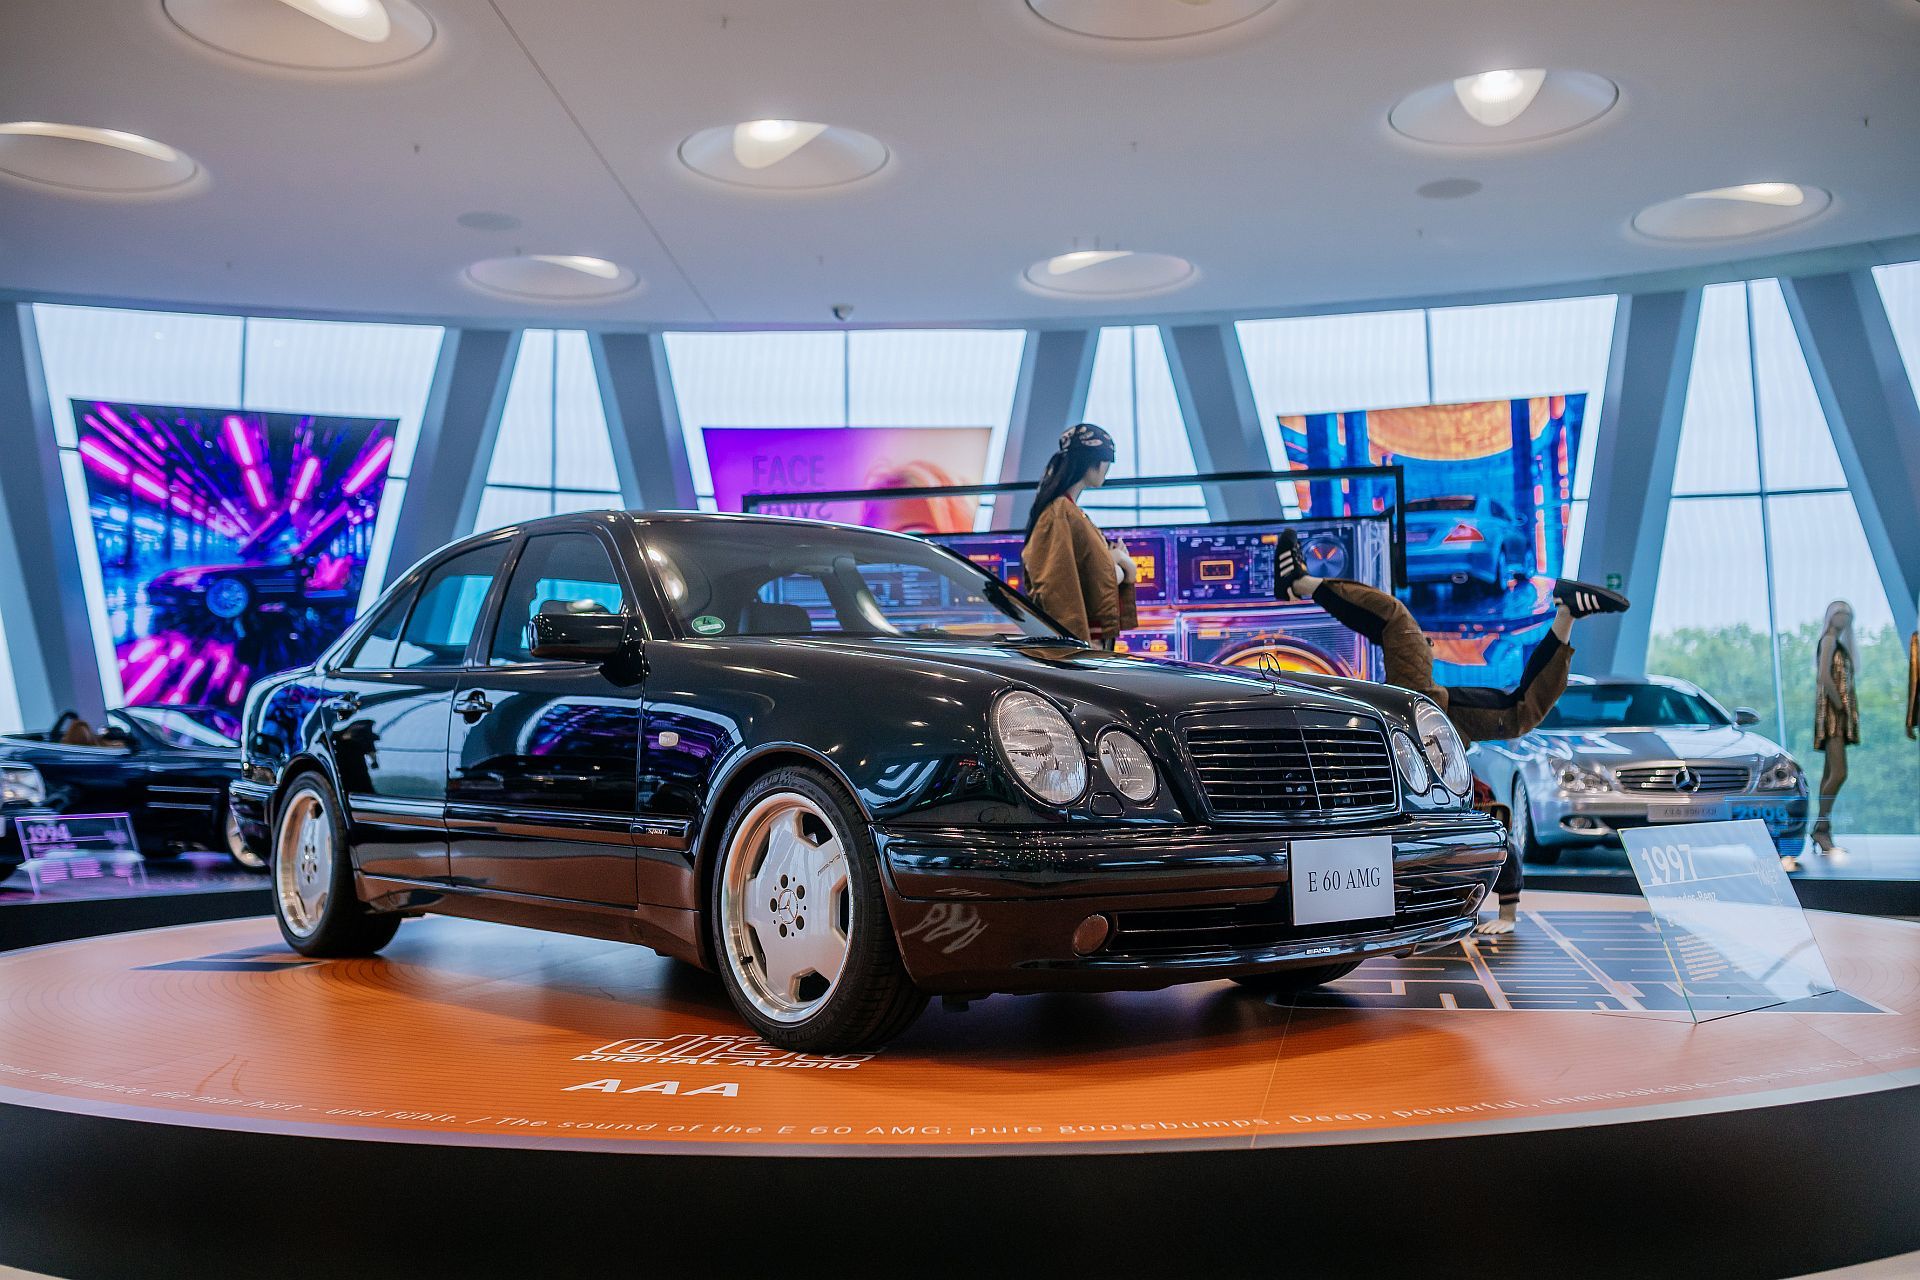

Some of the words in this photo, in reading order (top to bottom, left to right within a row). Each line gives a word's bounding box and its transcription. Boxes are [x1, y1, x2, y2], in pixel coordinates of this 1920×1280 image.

[752, 455, 824, 488] FACE
[1641, 844, 1699, 885] 1997
[1308, 871, 1318, 893] E
[1322, 870, 1341, 891] 60
[1345, 867, 1381, 890] AMG
[571, 1055, 719, 1065] DIGITAL
[728, 1060, 861, 1070] AUDIO
[561, 1078, 740, 1097] AAA
[243, 1100, 303, 1111] hört
[325, 1107, 384, 1117] und
[384, 1110, 456, 1123] fühlt.
[496, 1117, 548, 1127] The
[557, 1121, 657, 1132] sound
[667, 1124, 703, 1133] of
[711, 1125, 762, 1134] the
[777, 1125, 797, 1135] E
[810, 1126, 853, 1135] 60
[866, 1126, 952, 1135] AMG:
[970, 1126, 1043, 1137] pure
[1059, 1118, 1281, 1135] goosebumps.
[1289, 1112, 1387, 1124] Deep,
[1392, 1100, 1540, 1119] powerful,
